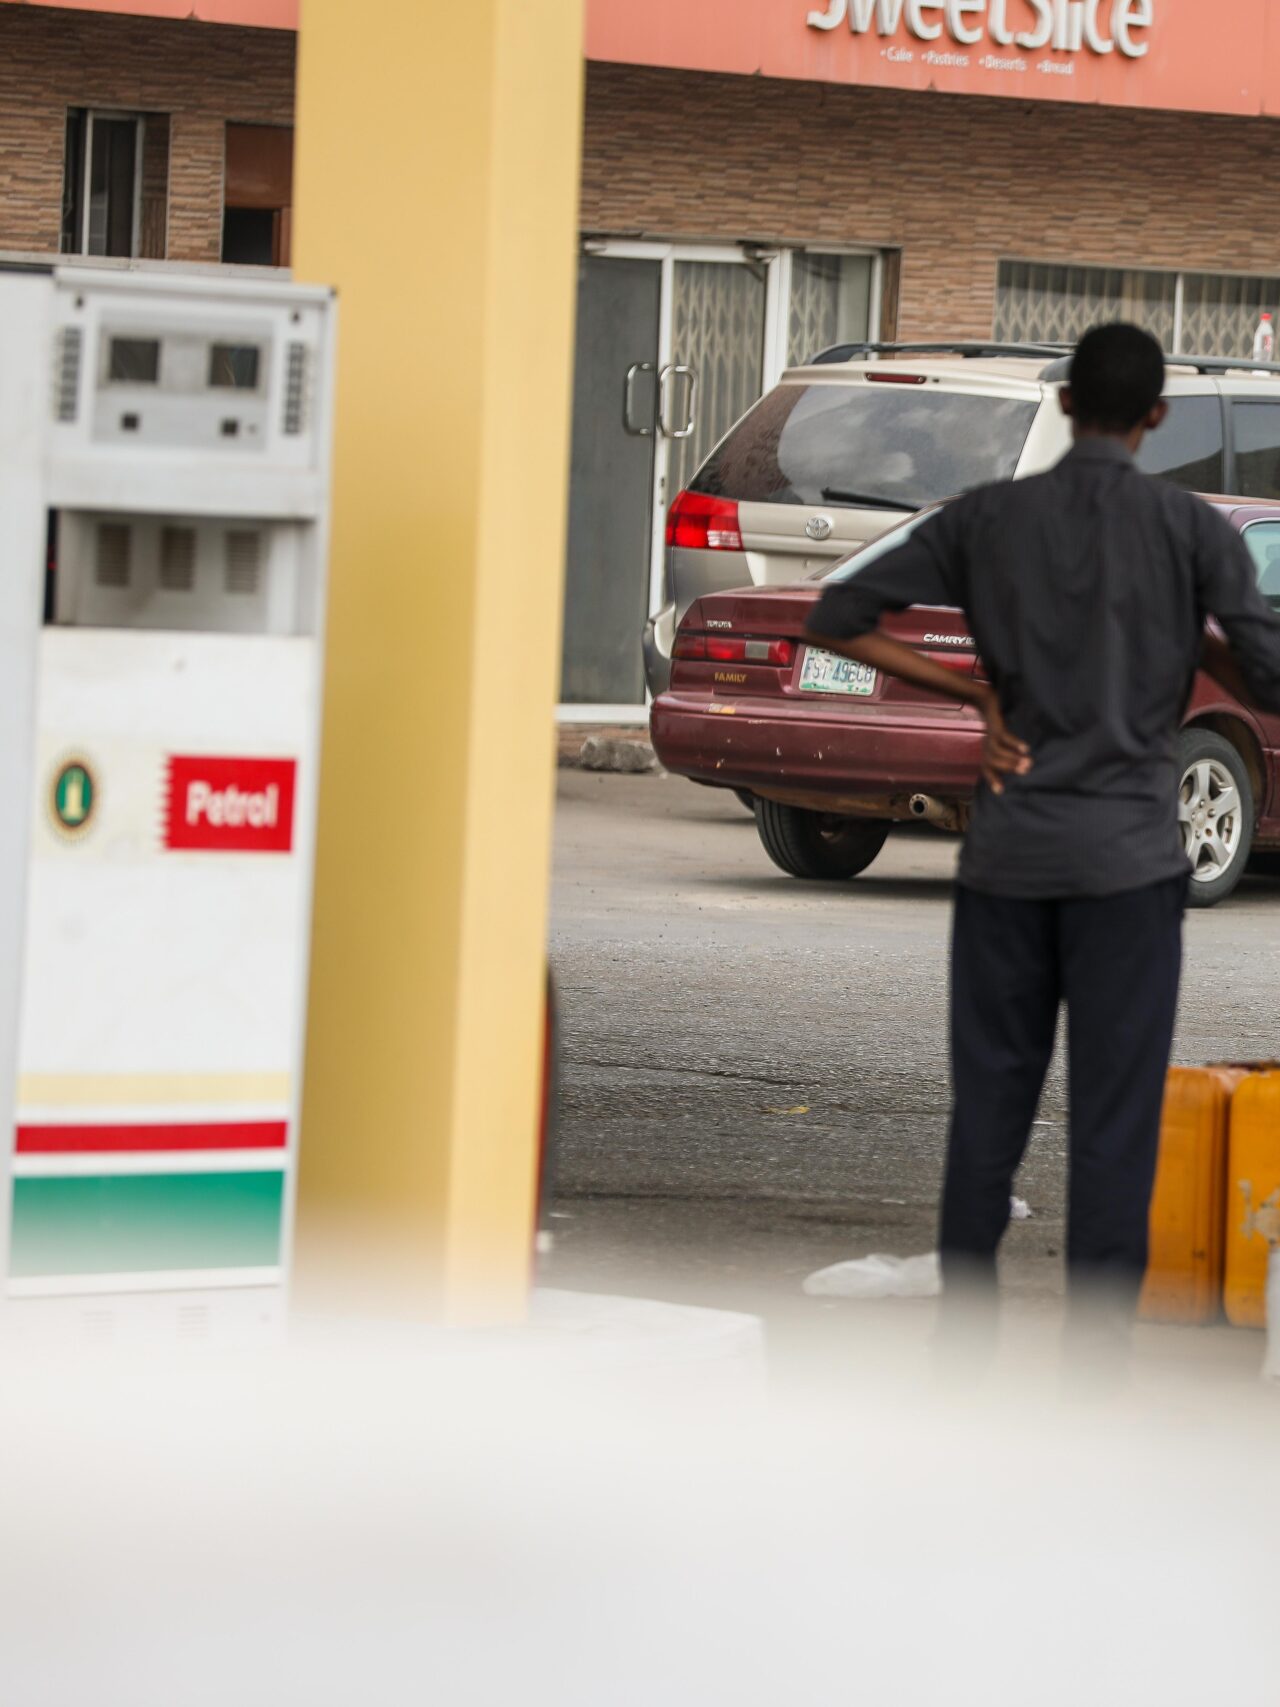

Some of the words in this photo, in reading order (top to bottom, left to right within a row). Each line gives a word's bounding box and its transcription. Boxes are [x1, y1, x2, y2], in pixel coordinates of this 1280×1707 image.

[923, 633, 965, 645] CAMRY
[714, 671, 747, 683] FAMILY
[186, 781, 279, 828] Petrol
